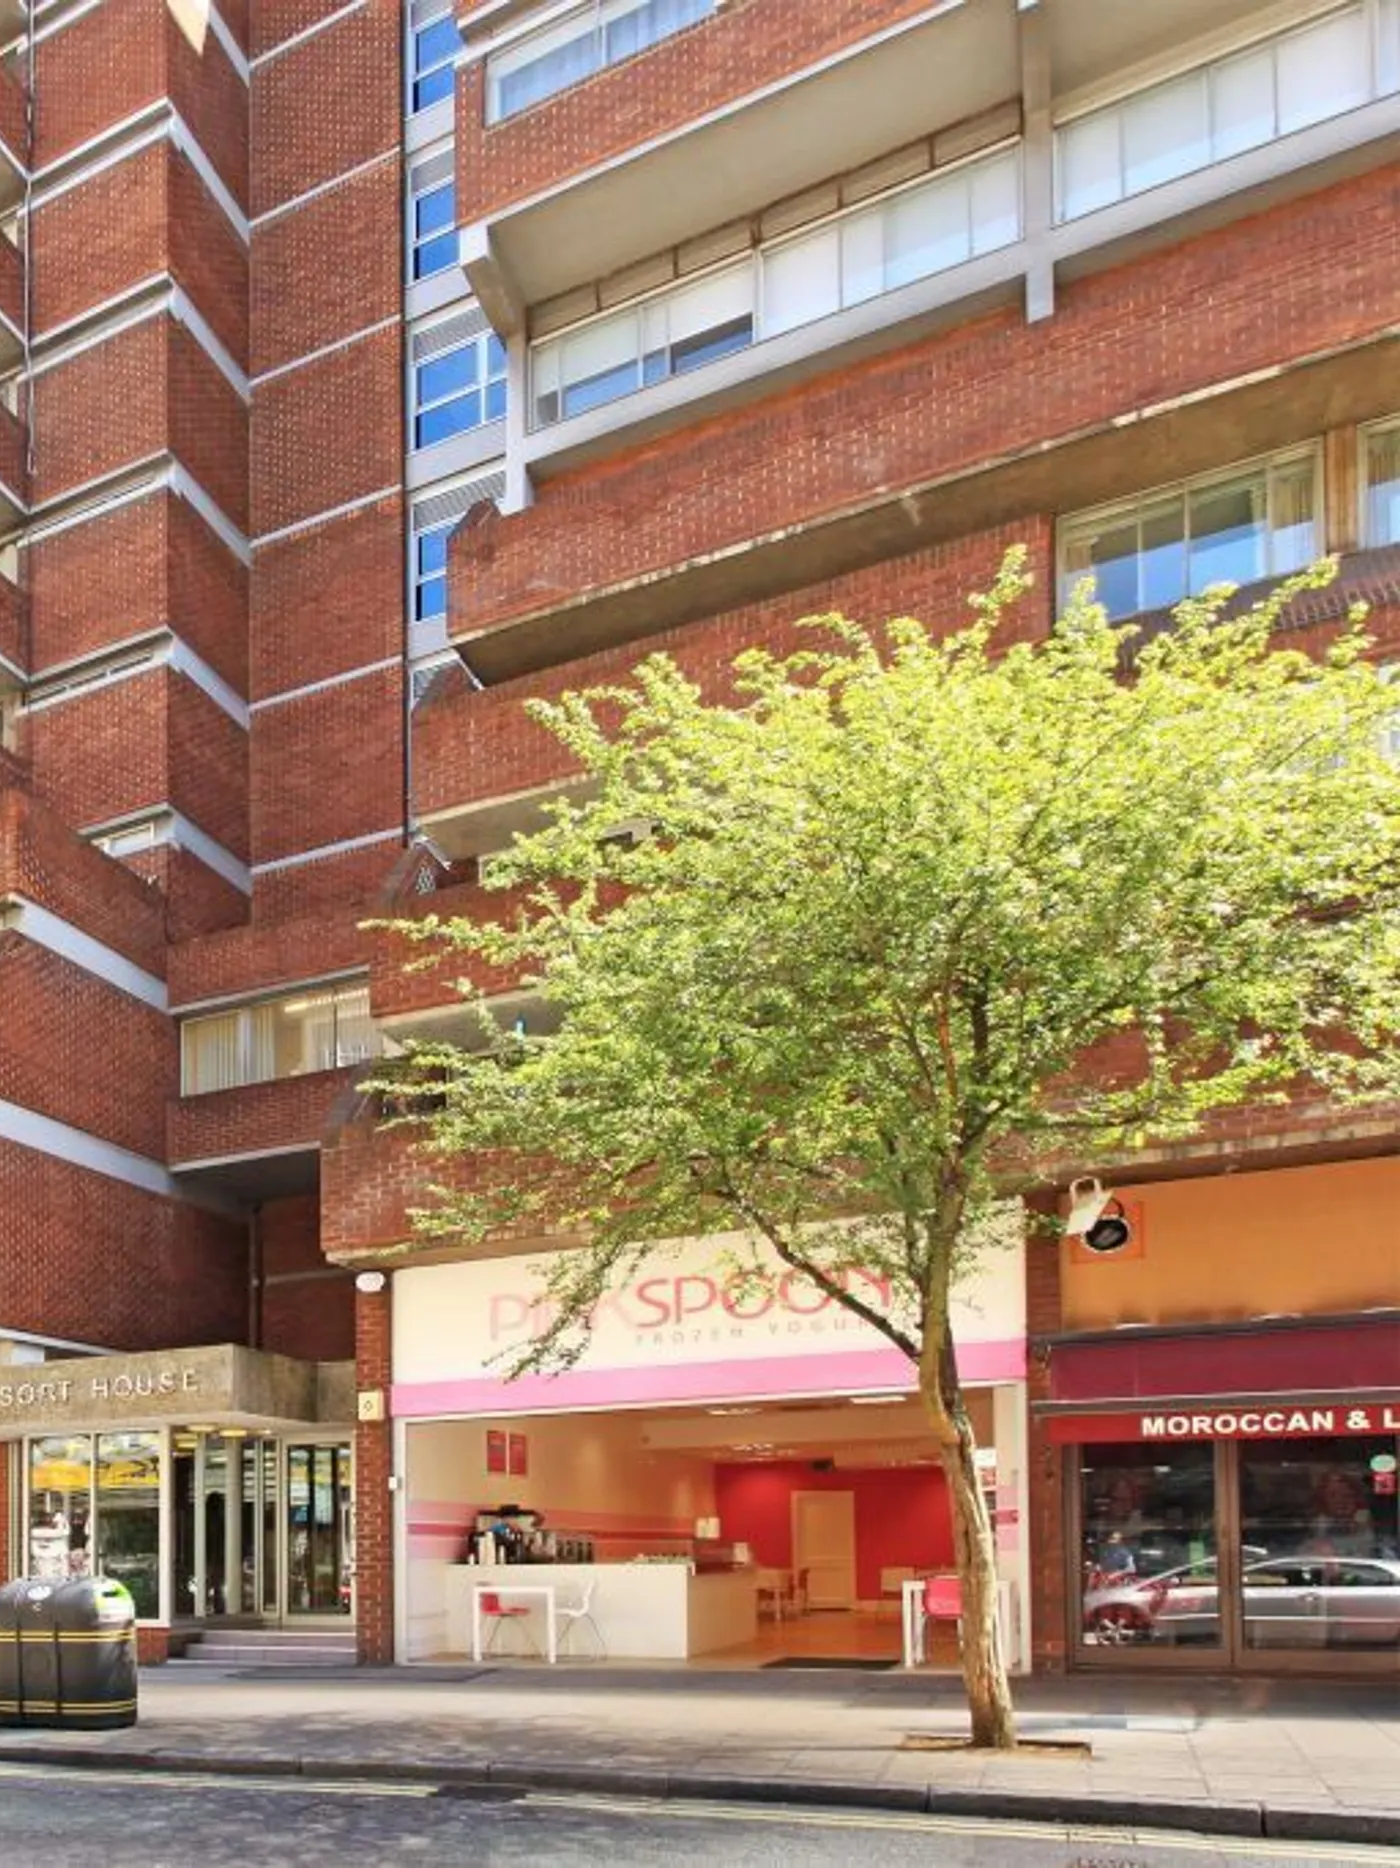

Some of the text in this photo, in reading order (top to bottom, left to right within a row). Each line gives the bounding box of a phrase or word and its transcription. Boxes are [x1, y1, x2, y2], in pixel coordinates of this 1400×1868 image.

[489, 1262, 892, 1341] PIKSPOON
[768, 1316, 884, 1335] YOGUR
[92, 1369, 200, 1399] HOUSE
[1141, 1410, 1335, 1437] MOROCCAN
[1346, 1409, 1372, 1430] &
